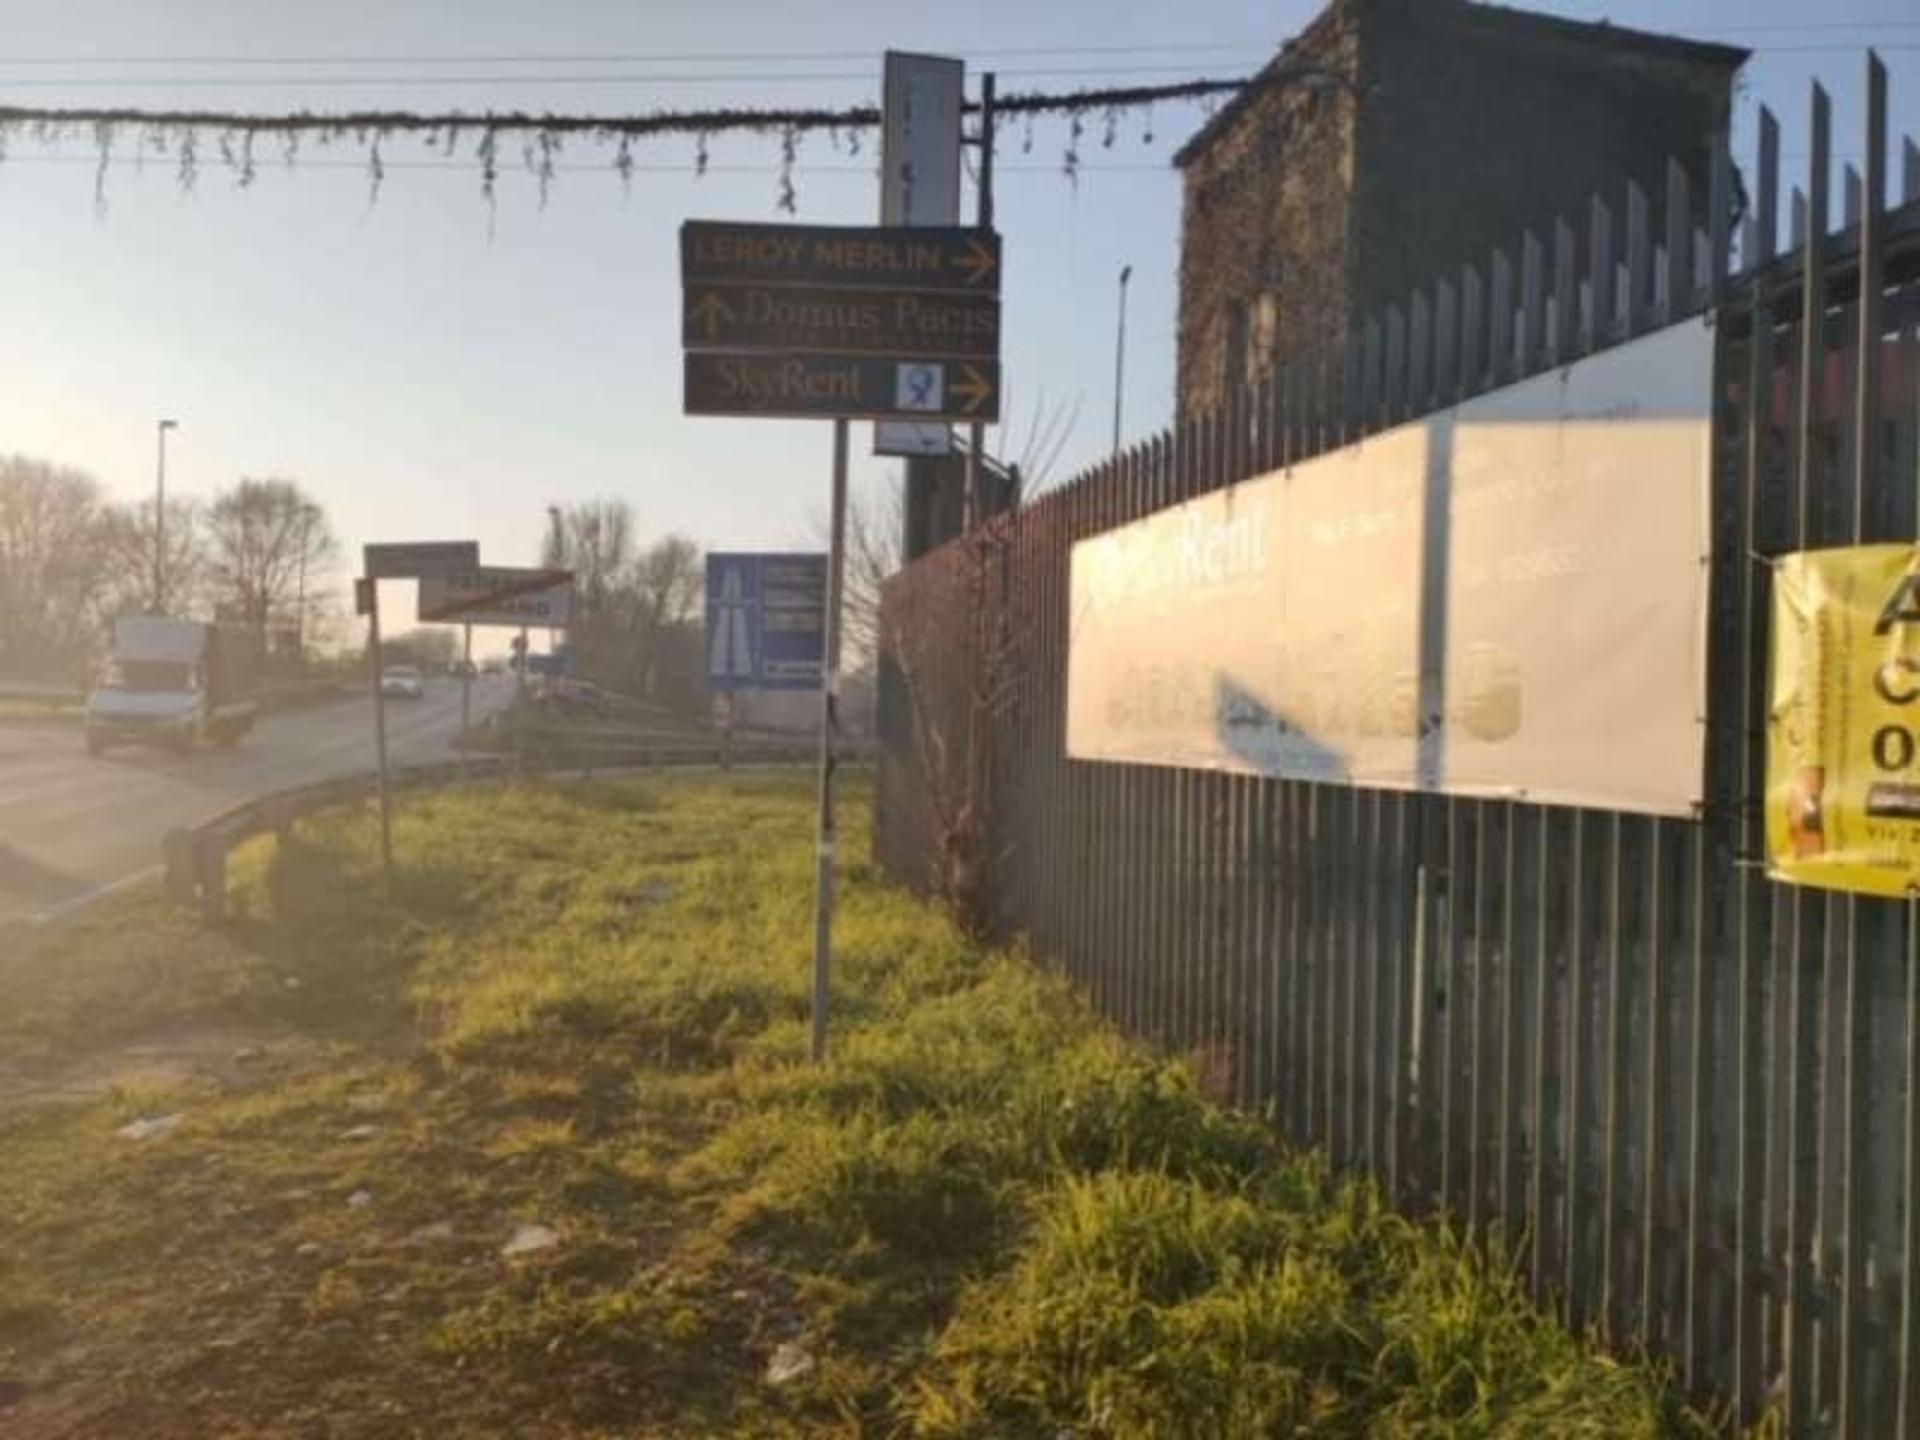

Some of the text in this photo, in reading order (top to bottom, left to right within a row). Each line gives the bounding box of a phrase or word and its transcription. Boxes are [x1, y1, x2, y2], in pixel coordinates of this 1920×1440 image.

[696, 235, 942, 270] LEROY MERLIN
[741, 292, 880, 328] Domus
